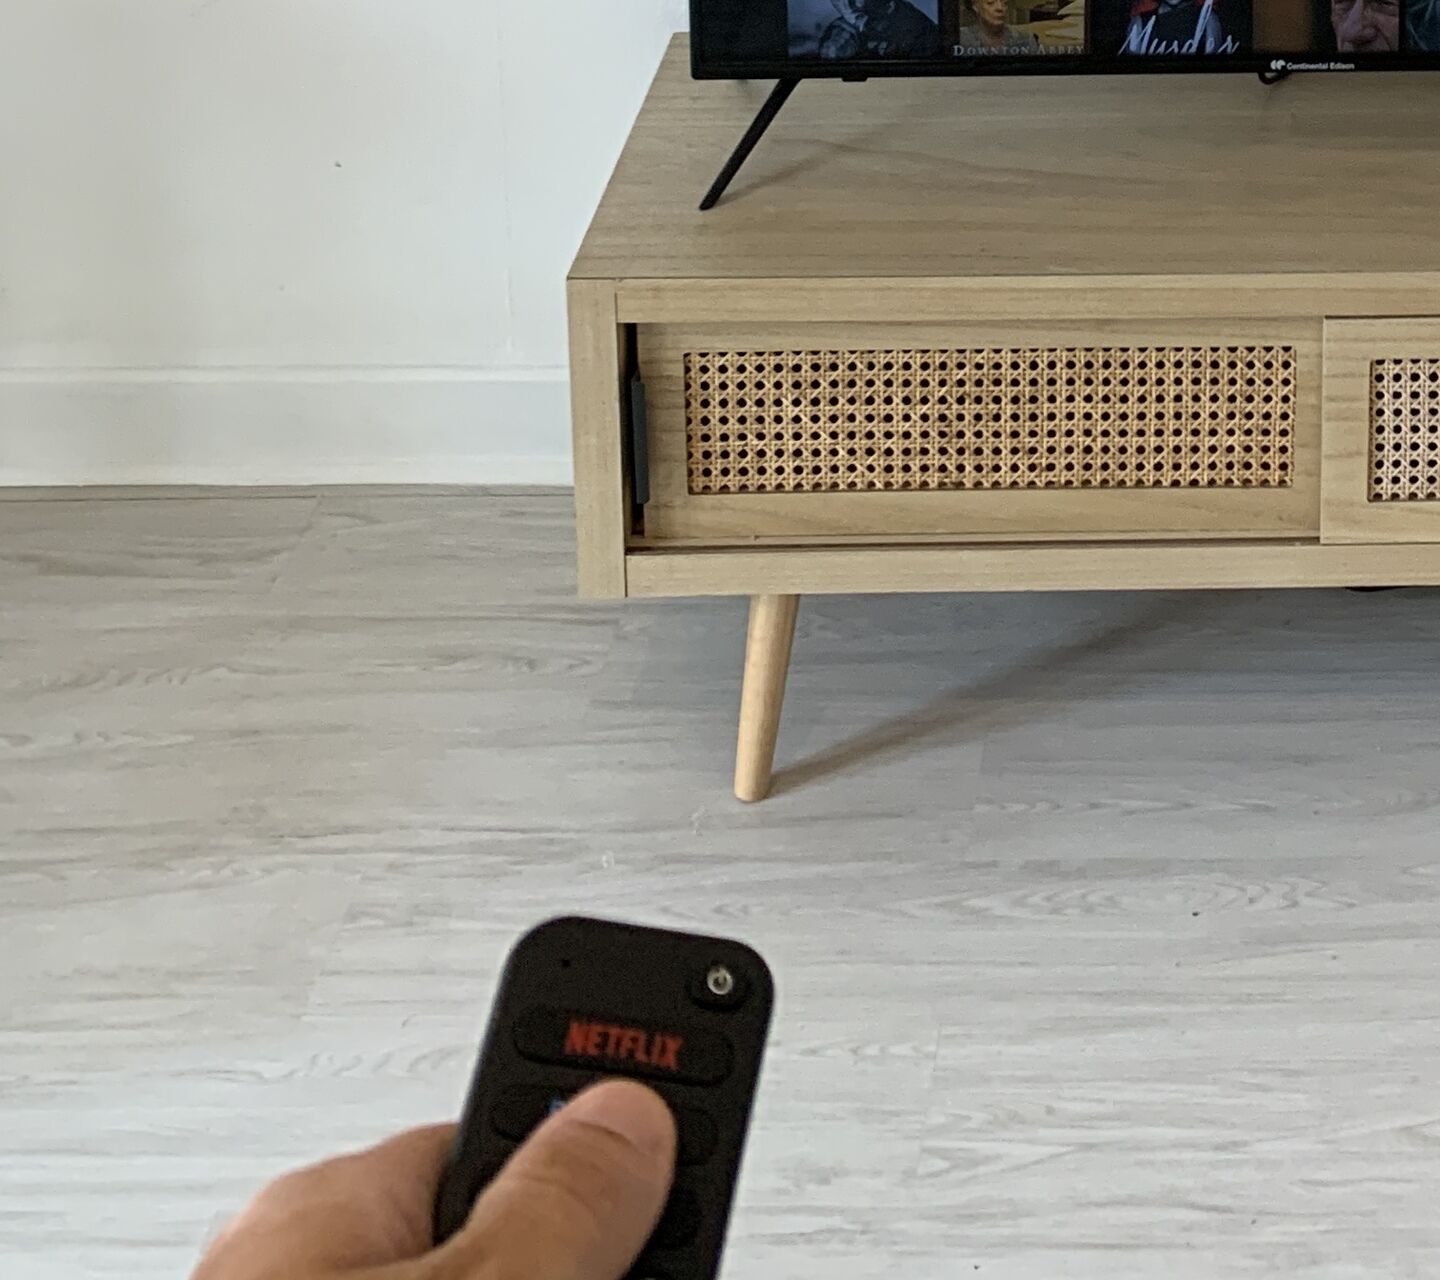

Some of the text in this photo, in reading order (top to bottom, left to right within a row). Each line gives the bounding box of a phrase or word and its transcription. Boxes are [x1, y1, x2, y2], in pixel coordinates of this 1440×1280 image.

[1286, 62, 1354, 70] Continental Edison
[564, 1021, 685, 1072] NETFLIX
